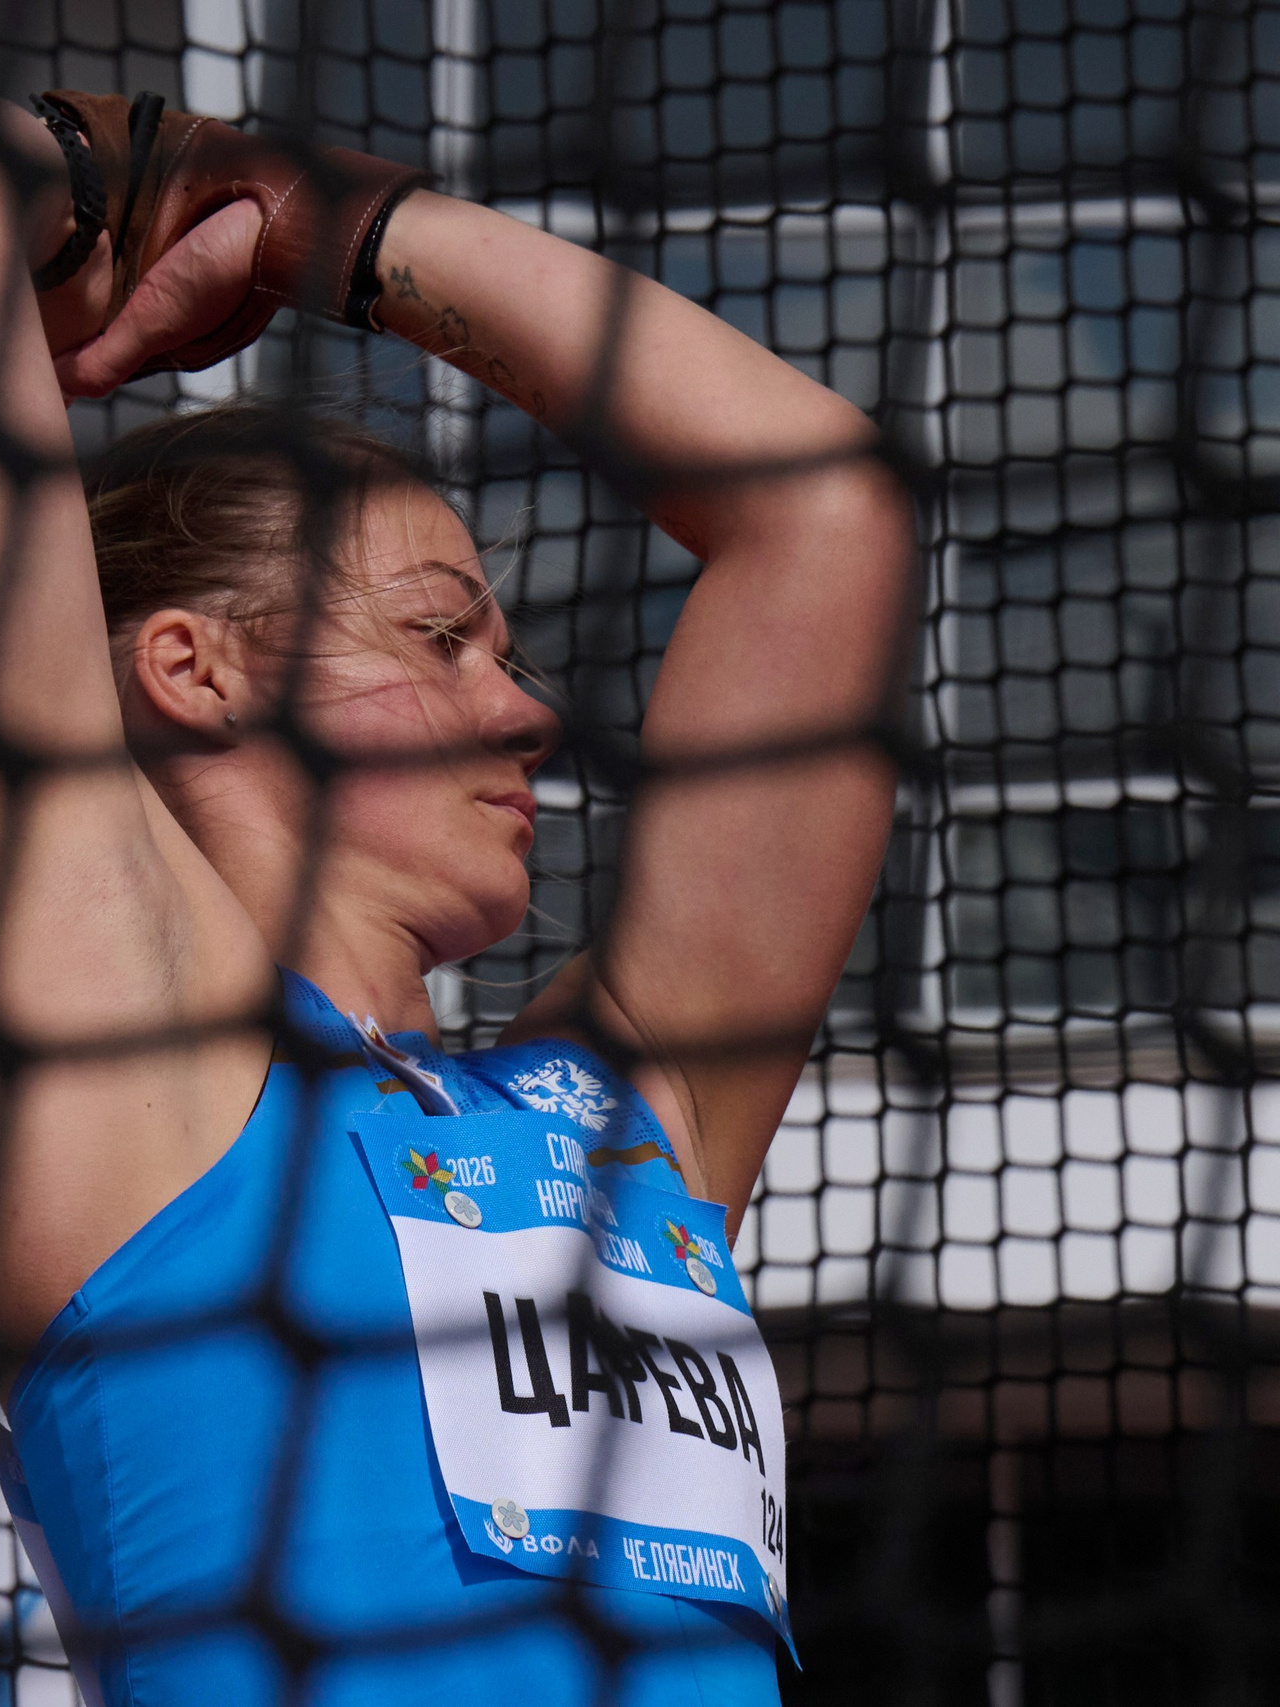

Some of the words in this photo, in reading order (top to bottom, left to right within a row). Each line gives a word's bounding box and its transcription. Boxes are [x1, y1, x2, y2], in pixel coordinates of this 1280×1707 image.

[446, 1155, 496, 1188] 2026
[483, 1291, 766, 1478] ЦАРЕВА
[761, 1487, 783, 1565] 124
[623, 1536, 747, 1593] ЧЕЛЯБИНСК
